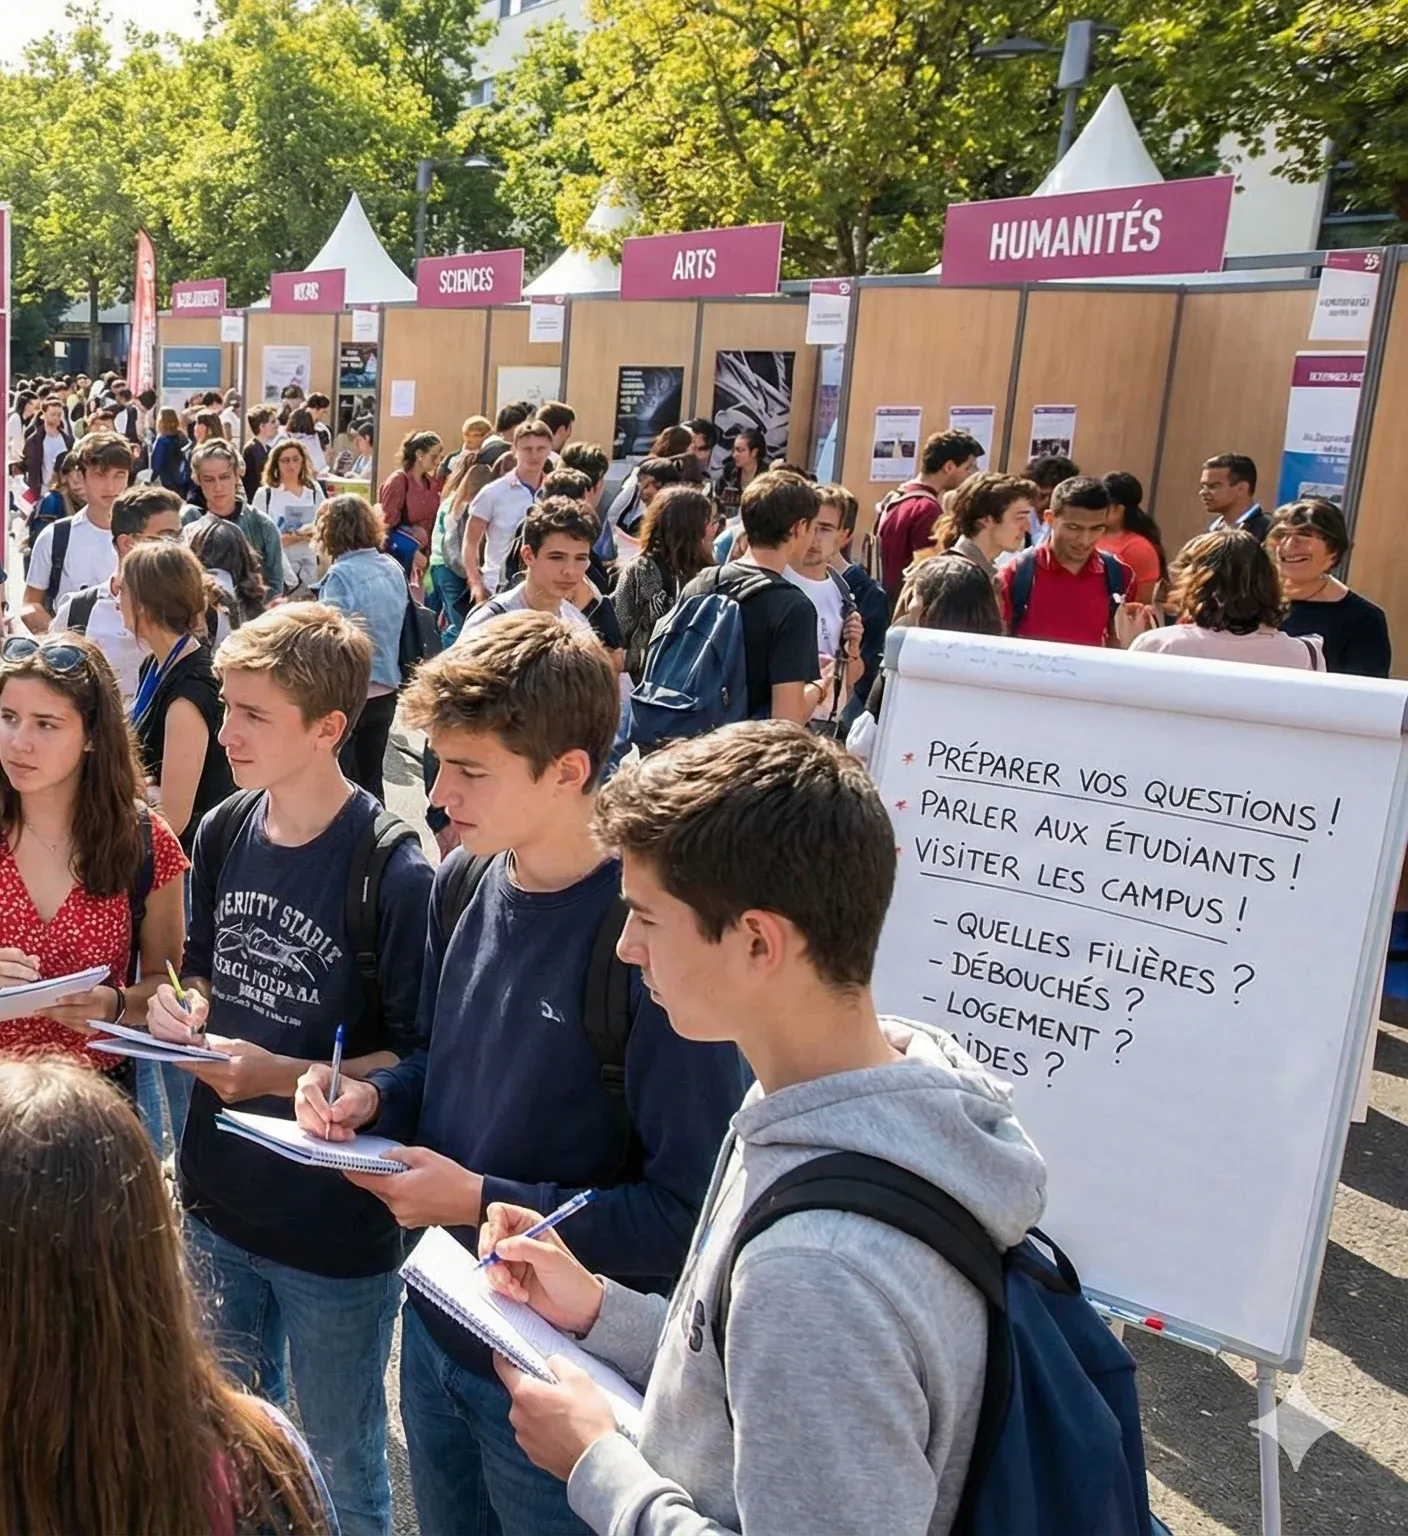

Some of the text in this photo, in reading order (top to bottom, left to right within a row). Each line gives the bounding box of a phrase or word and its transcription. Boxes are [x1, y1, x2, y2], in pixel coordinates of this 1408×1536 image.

[990, 198, 1163, 261] HUMANITÉS
[438, 266, 494, 294] SCIENCES
[672, 248, 717, 280] ARTS
[928, 740, 1061, 788] PRÉPARER
[1079, 768, 1128, 798] VOS
[920, 789, 1019, 834] PARLER
[1034, 815, 1090, 846] AUX
[1037, 863, 1086, 894] LES
[1101, 878, 1224, 925] CAMPUS
[956, 911, 1071, 959] QUELLES
[951, 950, 1110, 1012] DÉBOUCHÉS
[946, 990, 1101, 1052] LOGEMENT
